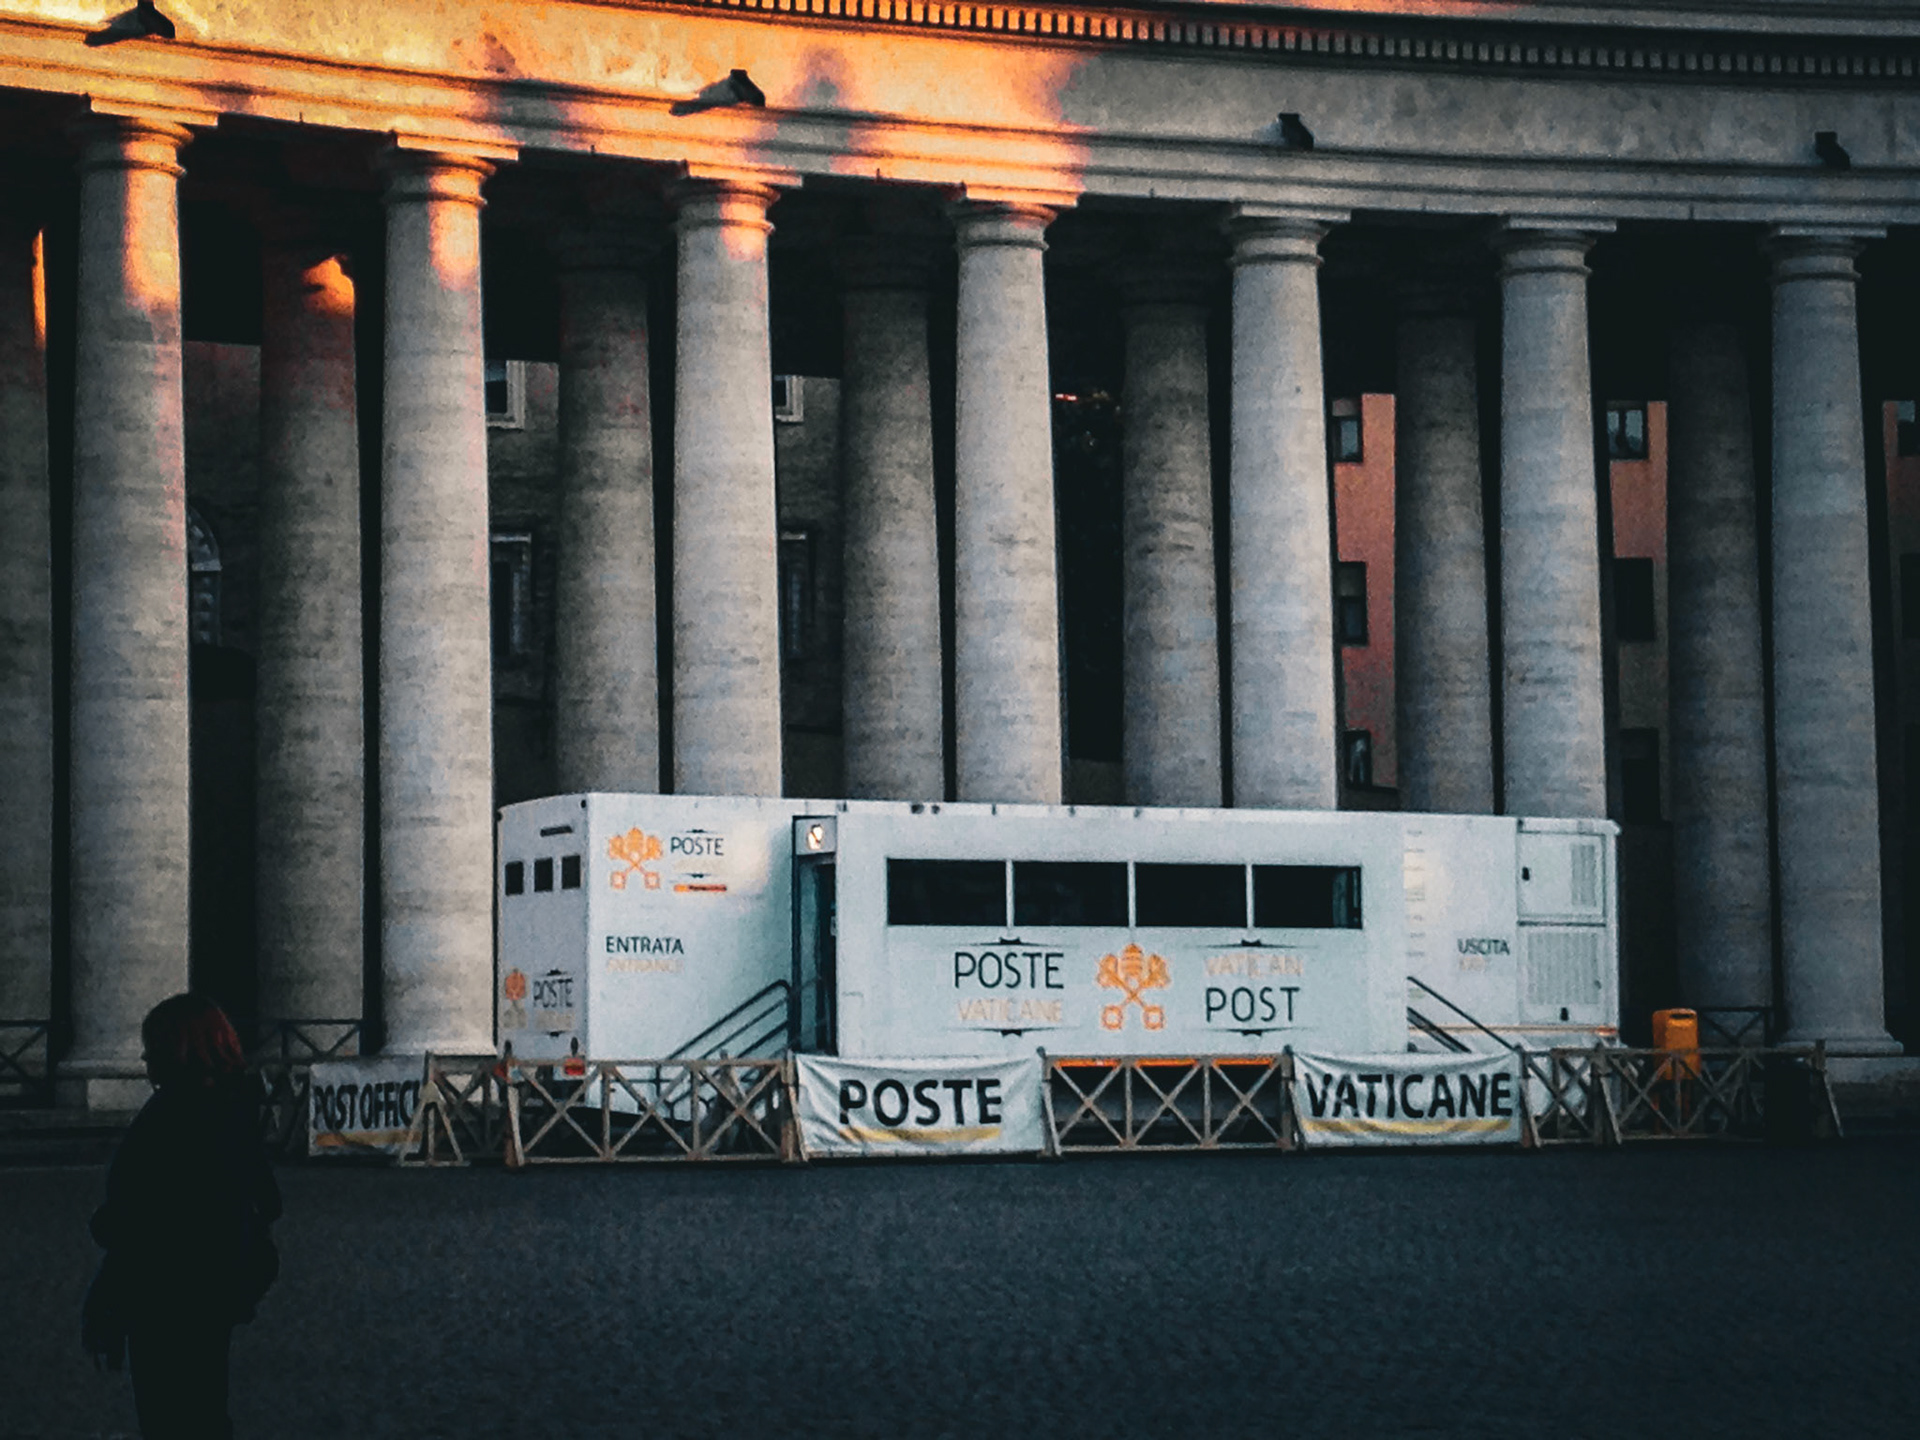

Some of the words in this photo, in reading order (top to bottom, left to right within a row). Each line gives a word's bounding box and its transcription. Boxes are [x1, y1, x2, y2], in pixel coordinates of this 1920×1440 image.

[670, 836, 725, 855] POSTE
[605, 936, 684, 955] ENTRATA
[1457, 938, 1510, 955] USCITA
[954, 952, 1064, 989] POSTE
[533, 978, 574, 1008] POSTE
[1206, 986, 1300, 1022] POST
[313, 1083, 358, 1130] POST
[839, 1078, 1002, 1127] POSTE
[1304, 1072, 1513, 1119] VATICANE
